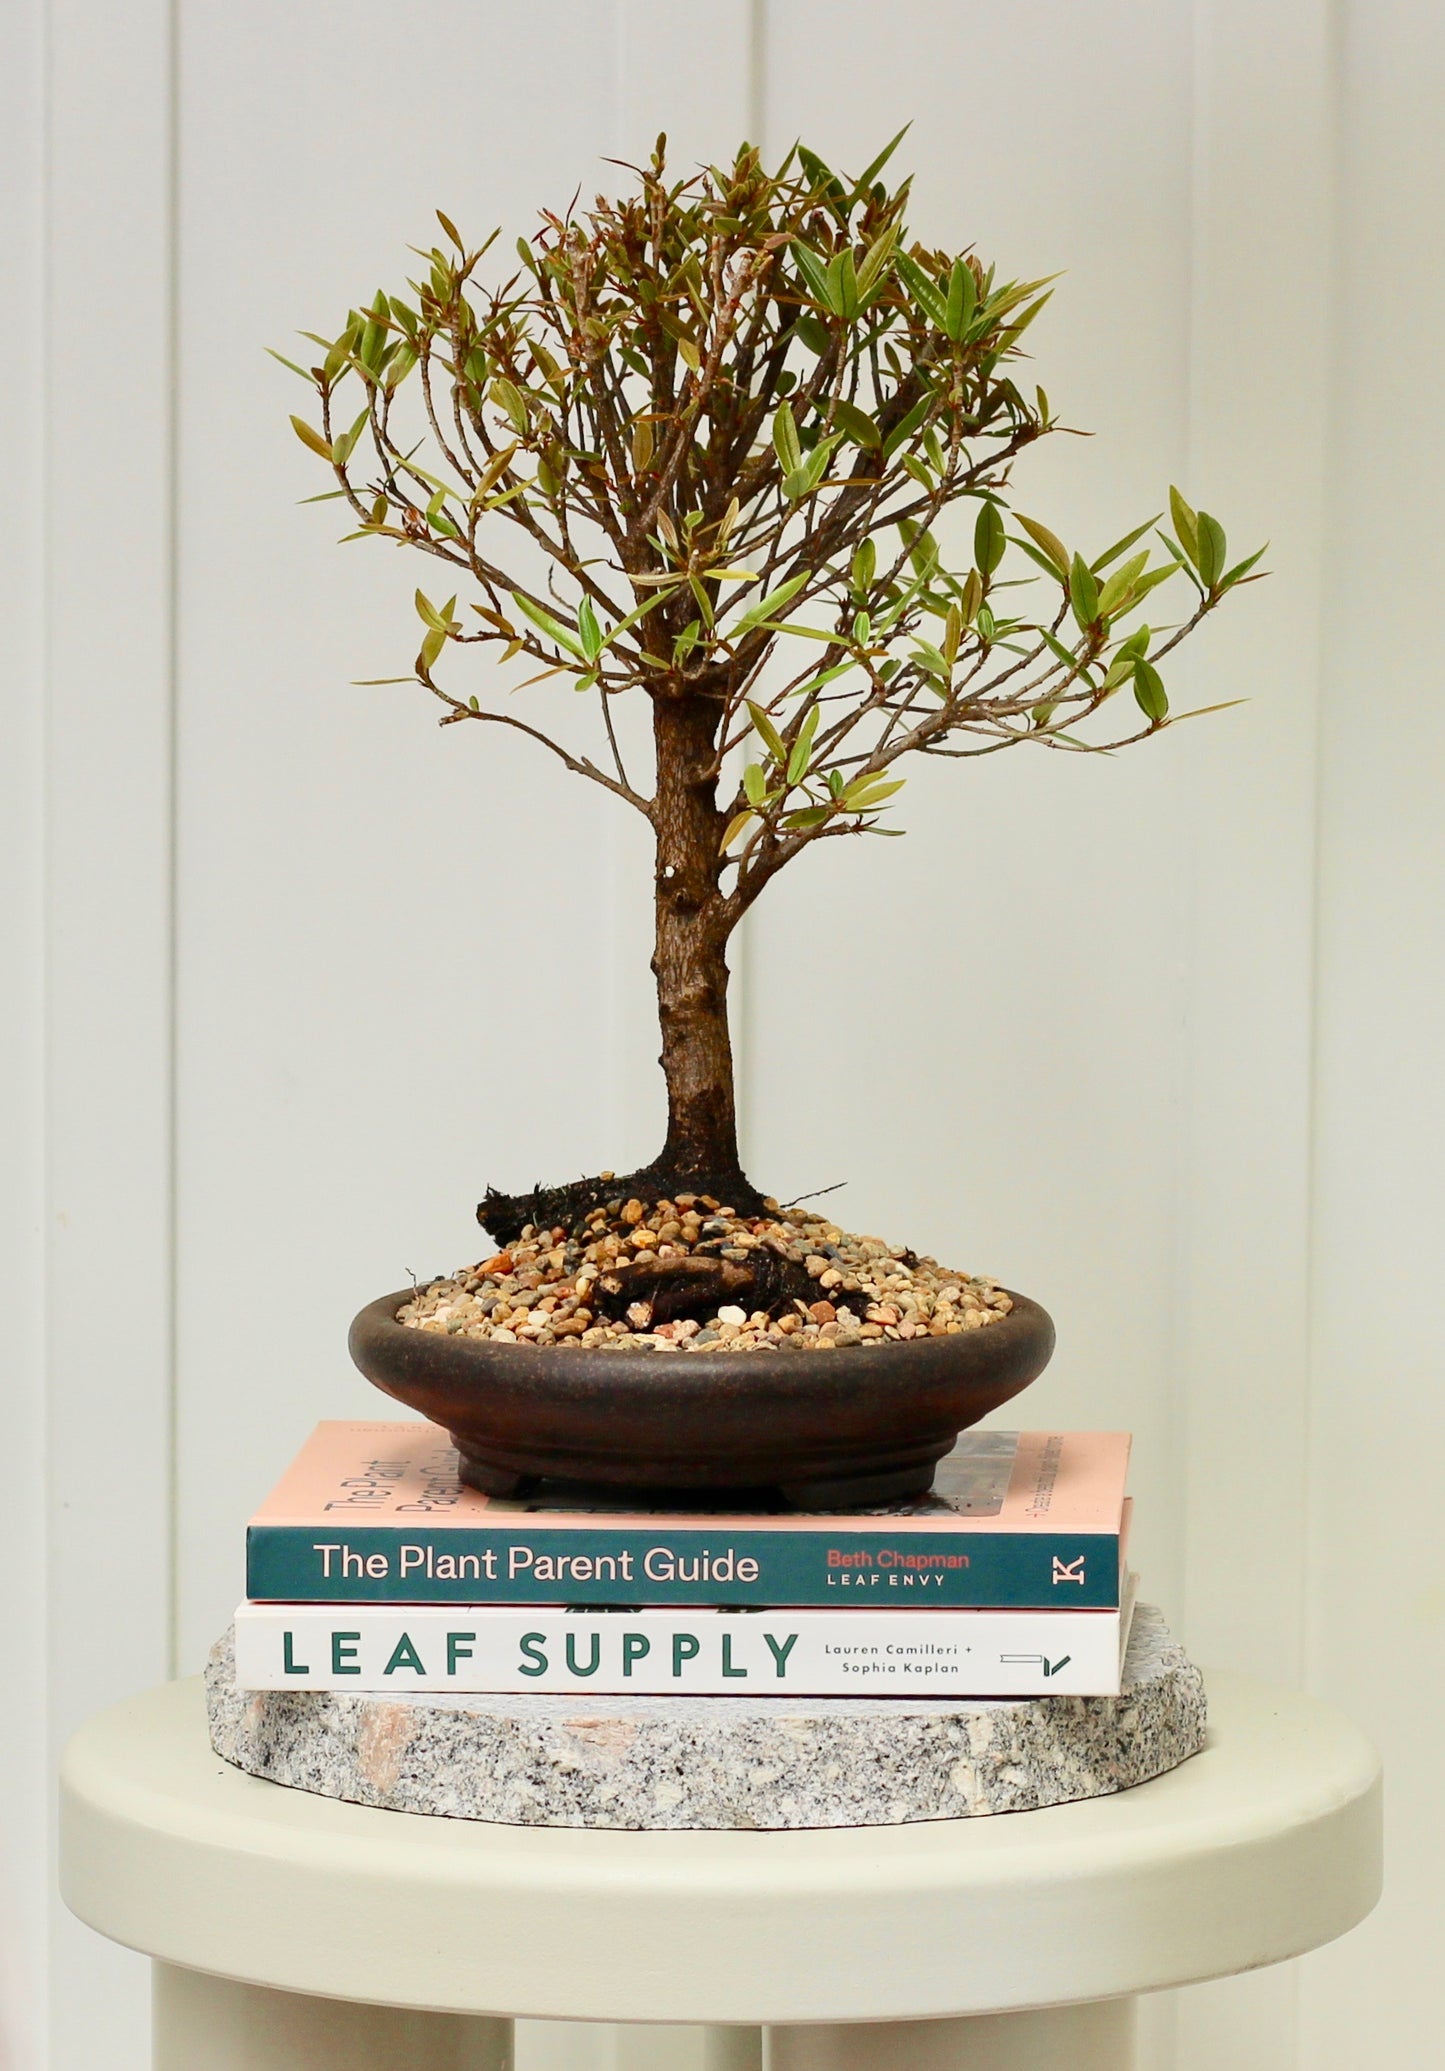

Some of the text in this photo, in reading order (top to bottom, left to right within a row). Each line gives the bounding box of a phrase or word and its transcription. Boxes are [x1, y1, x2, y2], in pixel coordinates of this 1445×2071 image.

[340, 1460, 411, 1488] Plant
[324, 1489, 392, 1511] The
[313, 1544, 760, 1583] The Plant Parent Guide
[827, 1550, 970, 1571] Beth Chapman
[1052, 1555, 1085, 1585] K
[827, 1574, 944, 1586] LEAF ENVY
[283, 1631, 799, 1678] LEAF SUPPLY
[825, 1644, 879, 1655] Lauren
[886, 1644, 958, 1655] Camilleri
[842, 1662, 959, 1675] Sophia Kaplan
